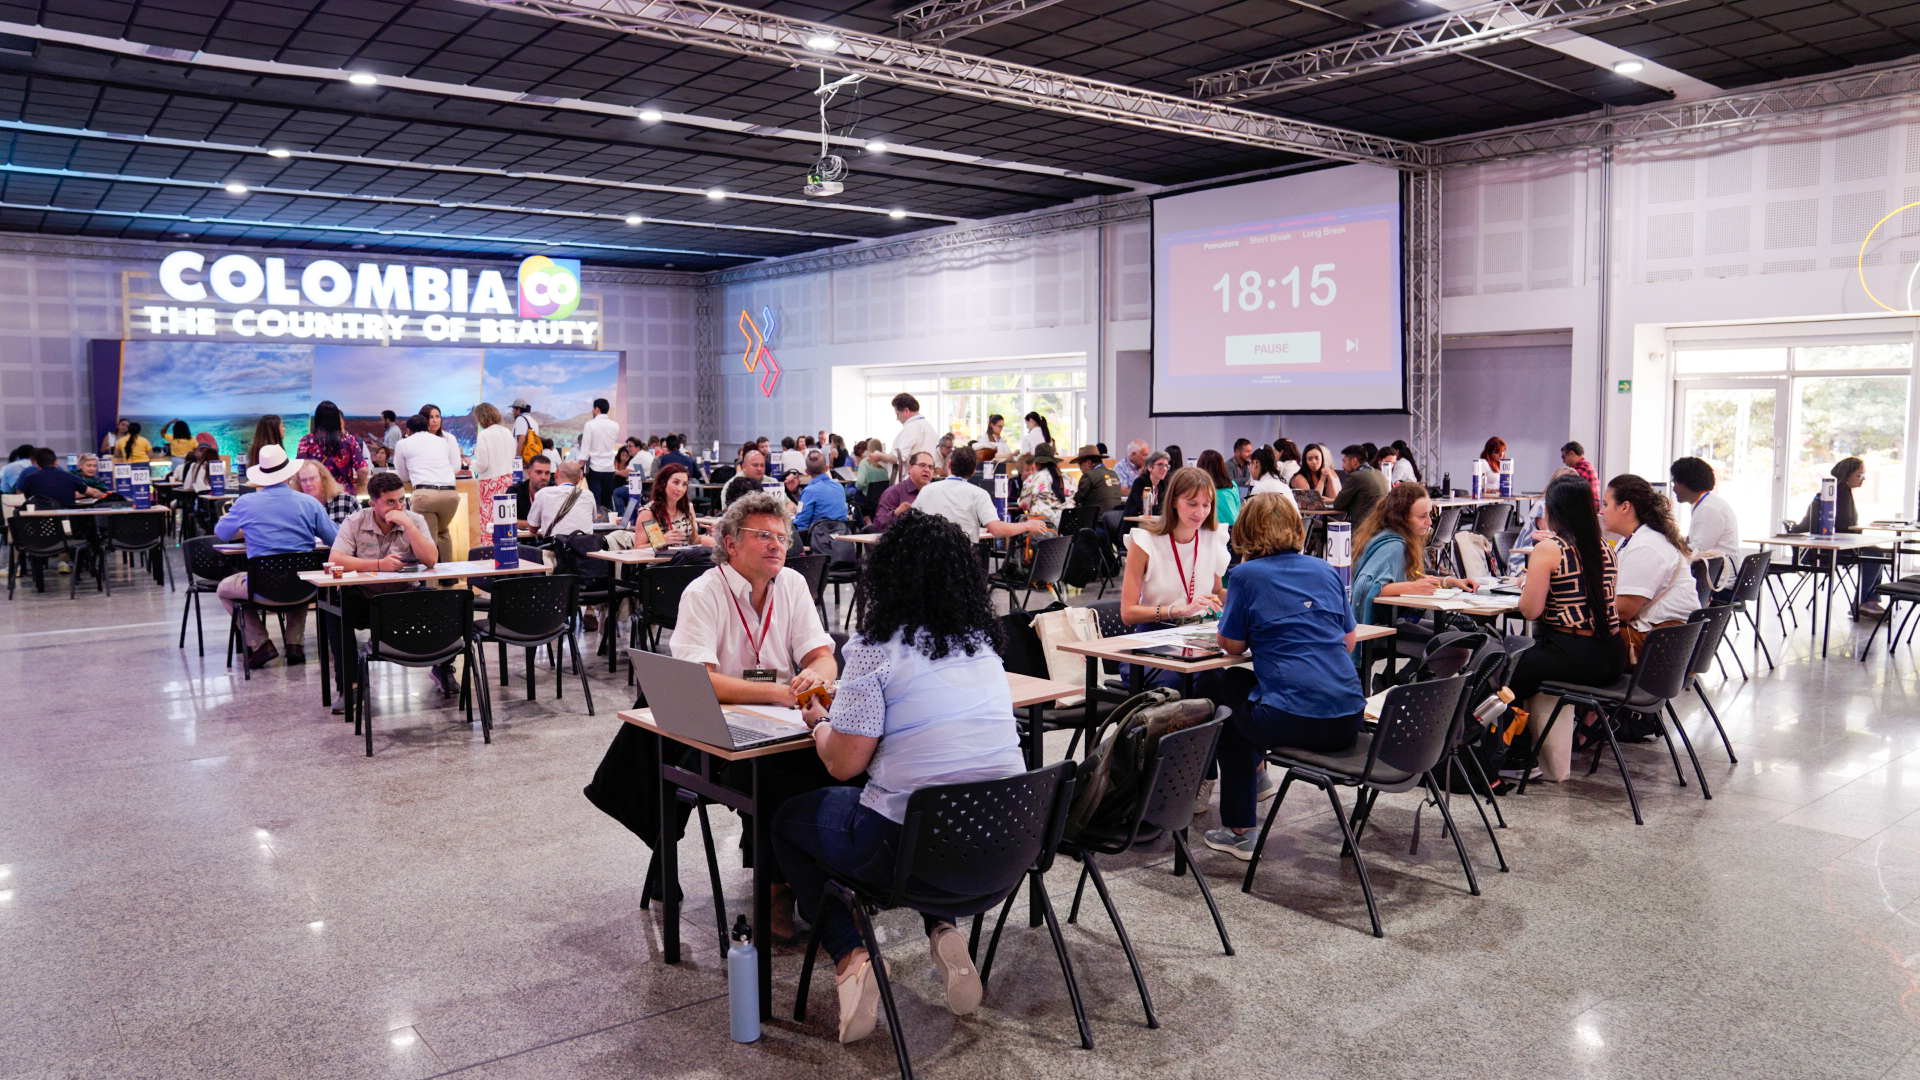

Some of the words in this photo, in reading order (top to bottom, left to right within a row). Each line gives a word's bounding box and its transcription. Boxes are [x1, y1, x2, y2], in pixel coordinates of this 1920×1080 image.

[1249, 235, 1269, 245] Short
[1270, 233, 1292, 242] Break
[1302, 230, 1322, 239] Long
[1323, 226, 1347, 236] Break
[1203, 240, 1240, 250] Pomodoro
[159, 250, 514, 315] COLOMBIA
[1212, 263, 1337, 313] 18:15
[144, 306, 216, 336] THE
[232, 309, 410, 341] COUNTRY
[422, 314, 466, 342] OF
[480, 318, 599, 345] BEAUTY
[1254, 343, 1290, 354] PAUSE
[133, 472, 148, 482] 027
[498, 503, 516, 519] 013
